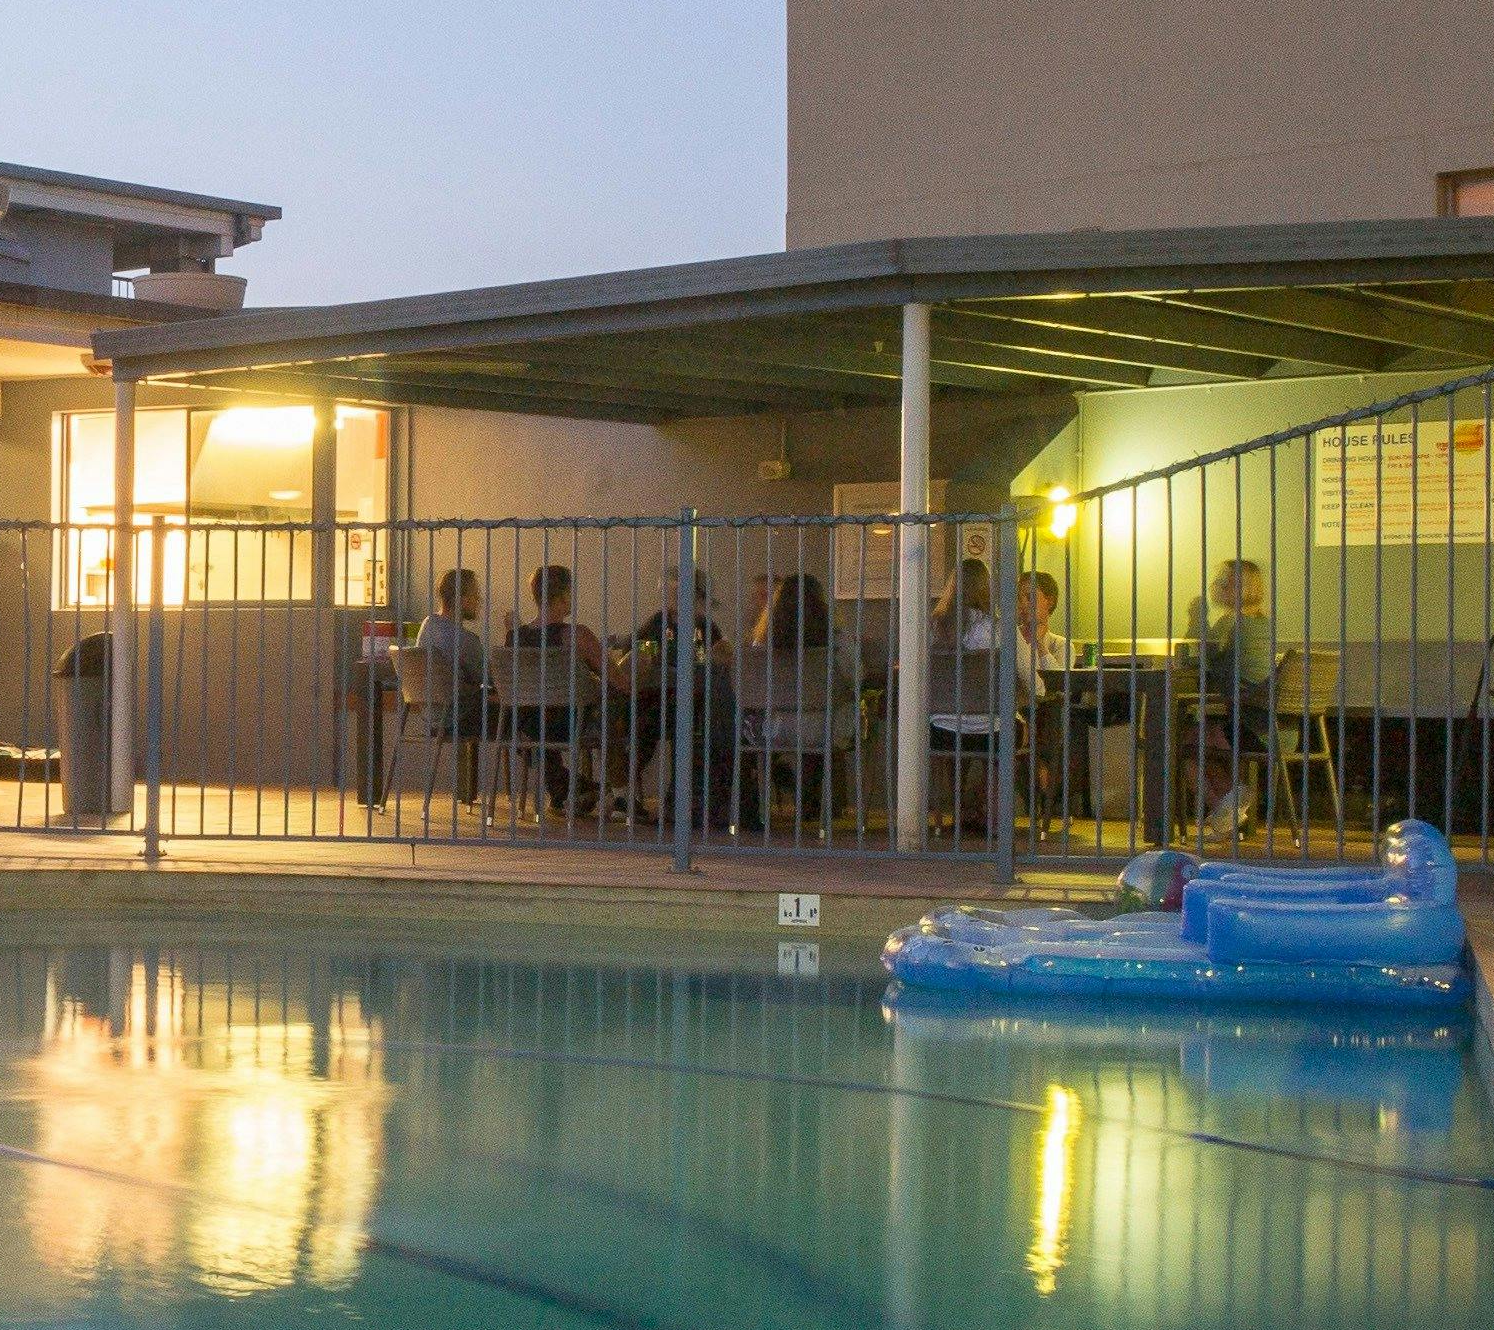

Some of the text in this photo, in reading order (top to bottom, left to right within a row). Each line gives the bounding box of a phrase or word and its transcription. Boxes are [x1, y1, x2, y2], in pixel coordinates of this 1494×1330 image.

[1322, 433, 1415, 448] HOUSE RULES
[1322, 456, 1357, 464] DRINNG
